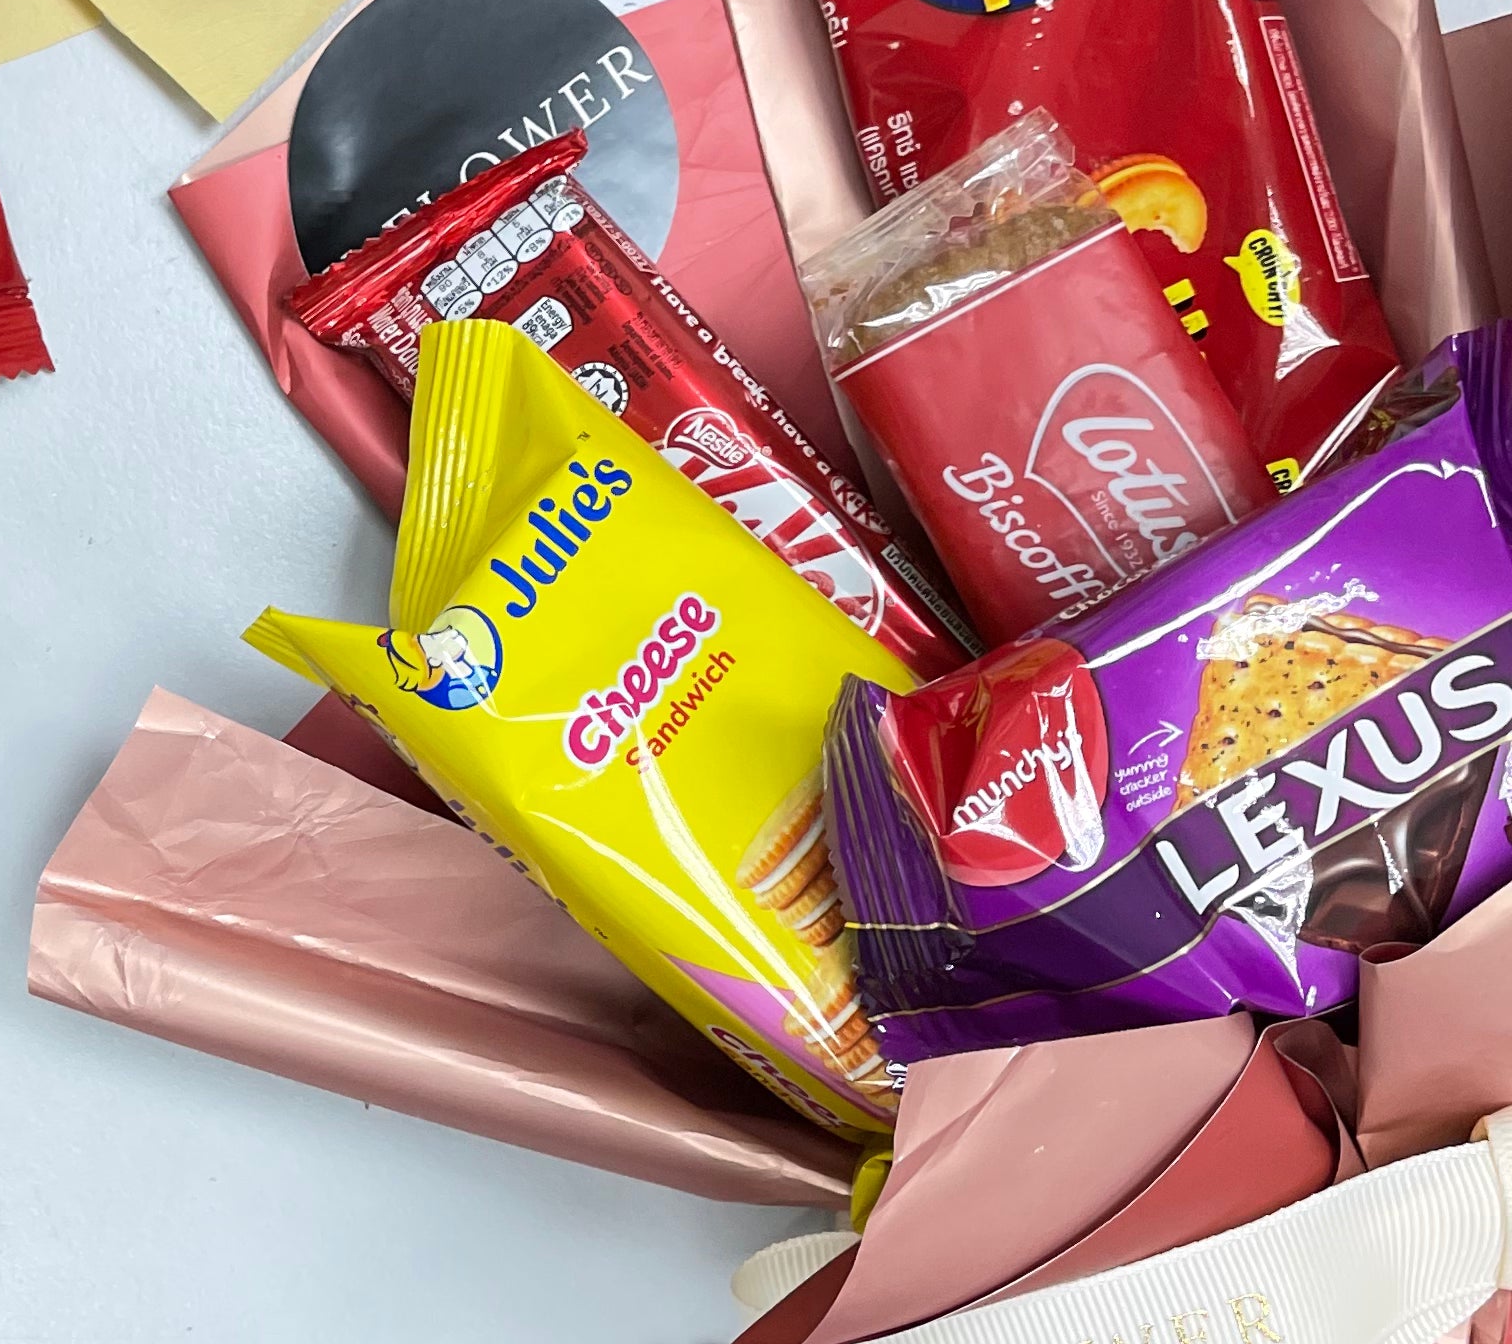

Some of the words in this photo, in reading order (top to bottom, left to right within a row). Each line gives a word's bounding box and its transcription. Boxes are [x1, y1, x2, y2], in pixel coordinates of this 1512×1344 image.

[534, 310, 558, 340] Tenaga
[541, 299, 572, 330] Energy/
[650, 272, 701, 329] Have
[696, 325, 715, 344] a
[711, 340, 776, 413] break,
[769, 407, 819, 463] have
[814, 458, 832, 476] a
[680, 412, 752, 467] Nestlé
[490, 457, 633, 619] Julie's
[942, 451, 1107, 619] Biscoff
[567, 596, 718, 767] Cheese
[625, 648, 737, 773] Sandwich
[1114, 752, 1169, 782] yummy
[1119, 770, 1168, 796] cracker
[1125, 788, 1172, 812] outside
[1155, 656, 1512, 913] LEXUS
